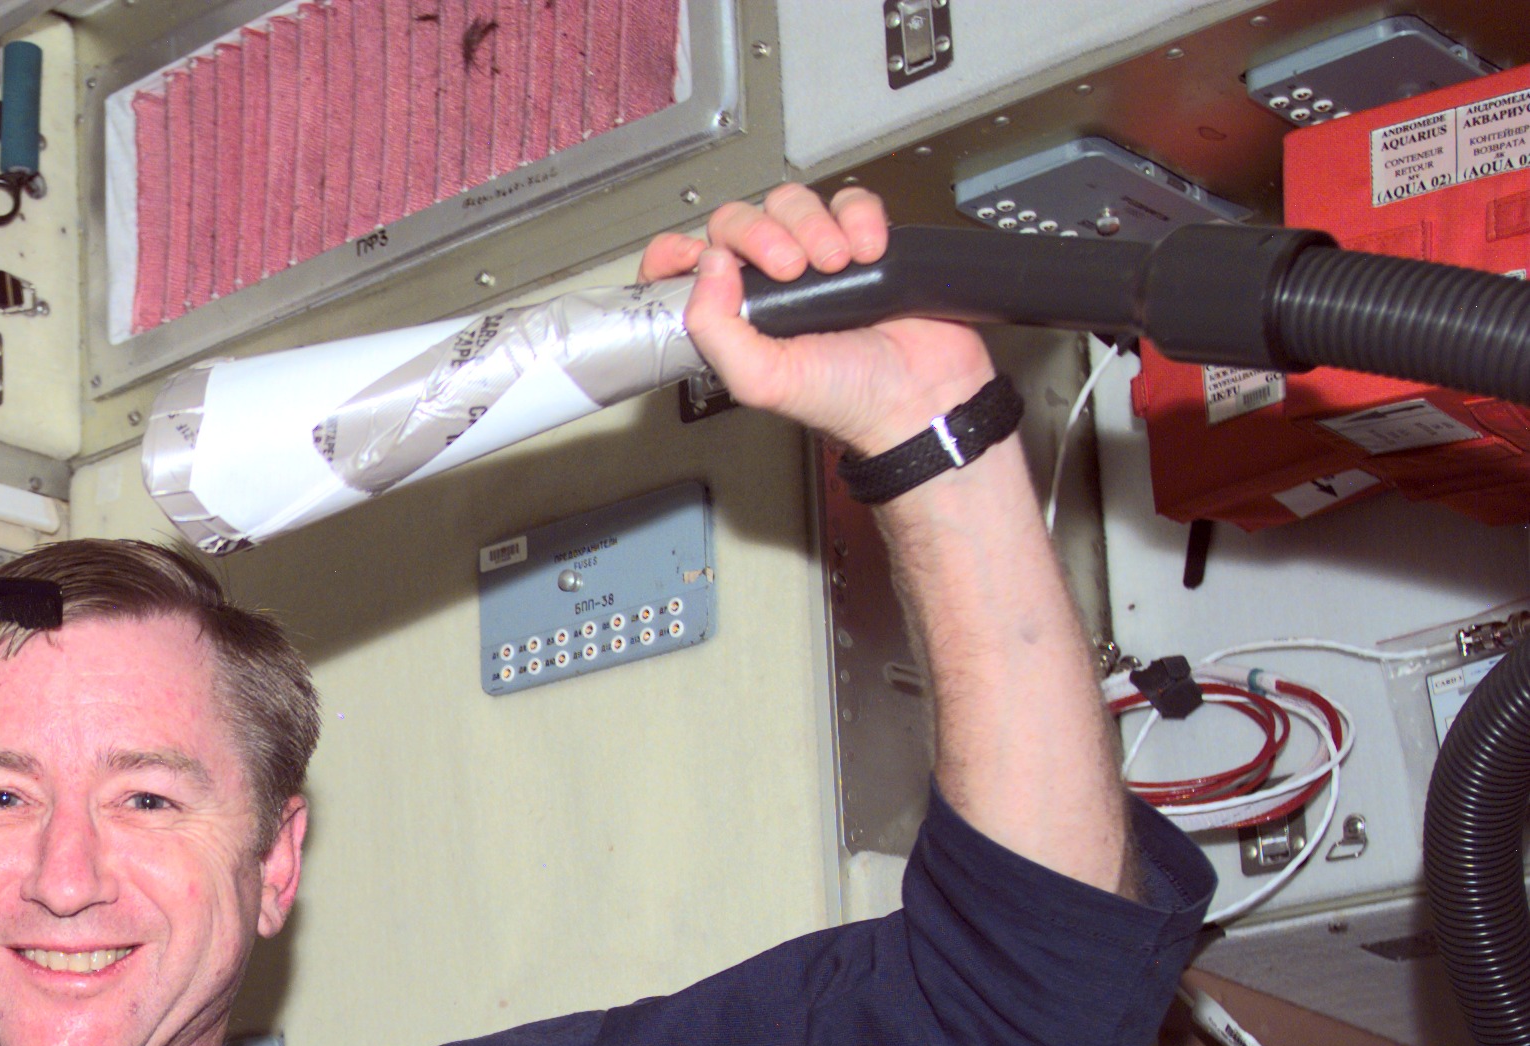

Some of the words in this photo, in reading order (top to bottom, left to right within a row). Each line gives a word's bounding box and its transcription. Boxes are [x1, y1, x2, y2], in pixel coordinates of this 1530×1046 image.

[1381, 114, 1446, 138] ANDROMEDE
[1381, 124, 1448, 151] AQUARIUS
[1473, 138, 1526, 157] ВОЗВРАТА
[1384, 147, 1444, 169] CONTENEUR
[1394, 161, 1434, 178] RETOUR
[1377, 180, 1427, 203] (AQUA
[1431, 173, 1452, 188] 02)
[573, 557, 599, 570] FUSES
[574, 593, 615, 615] БПП-38
